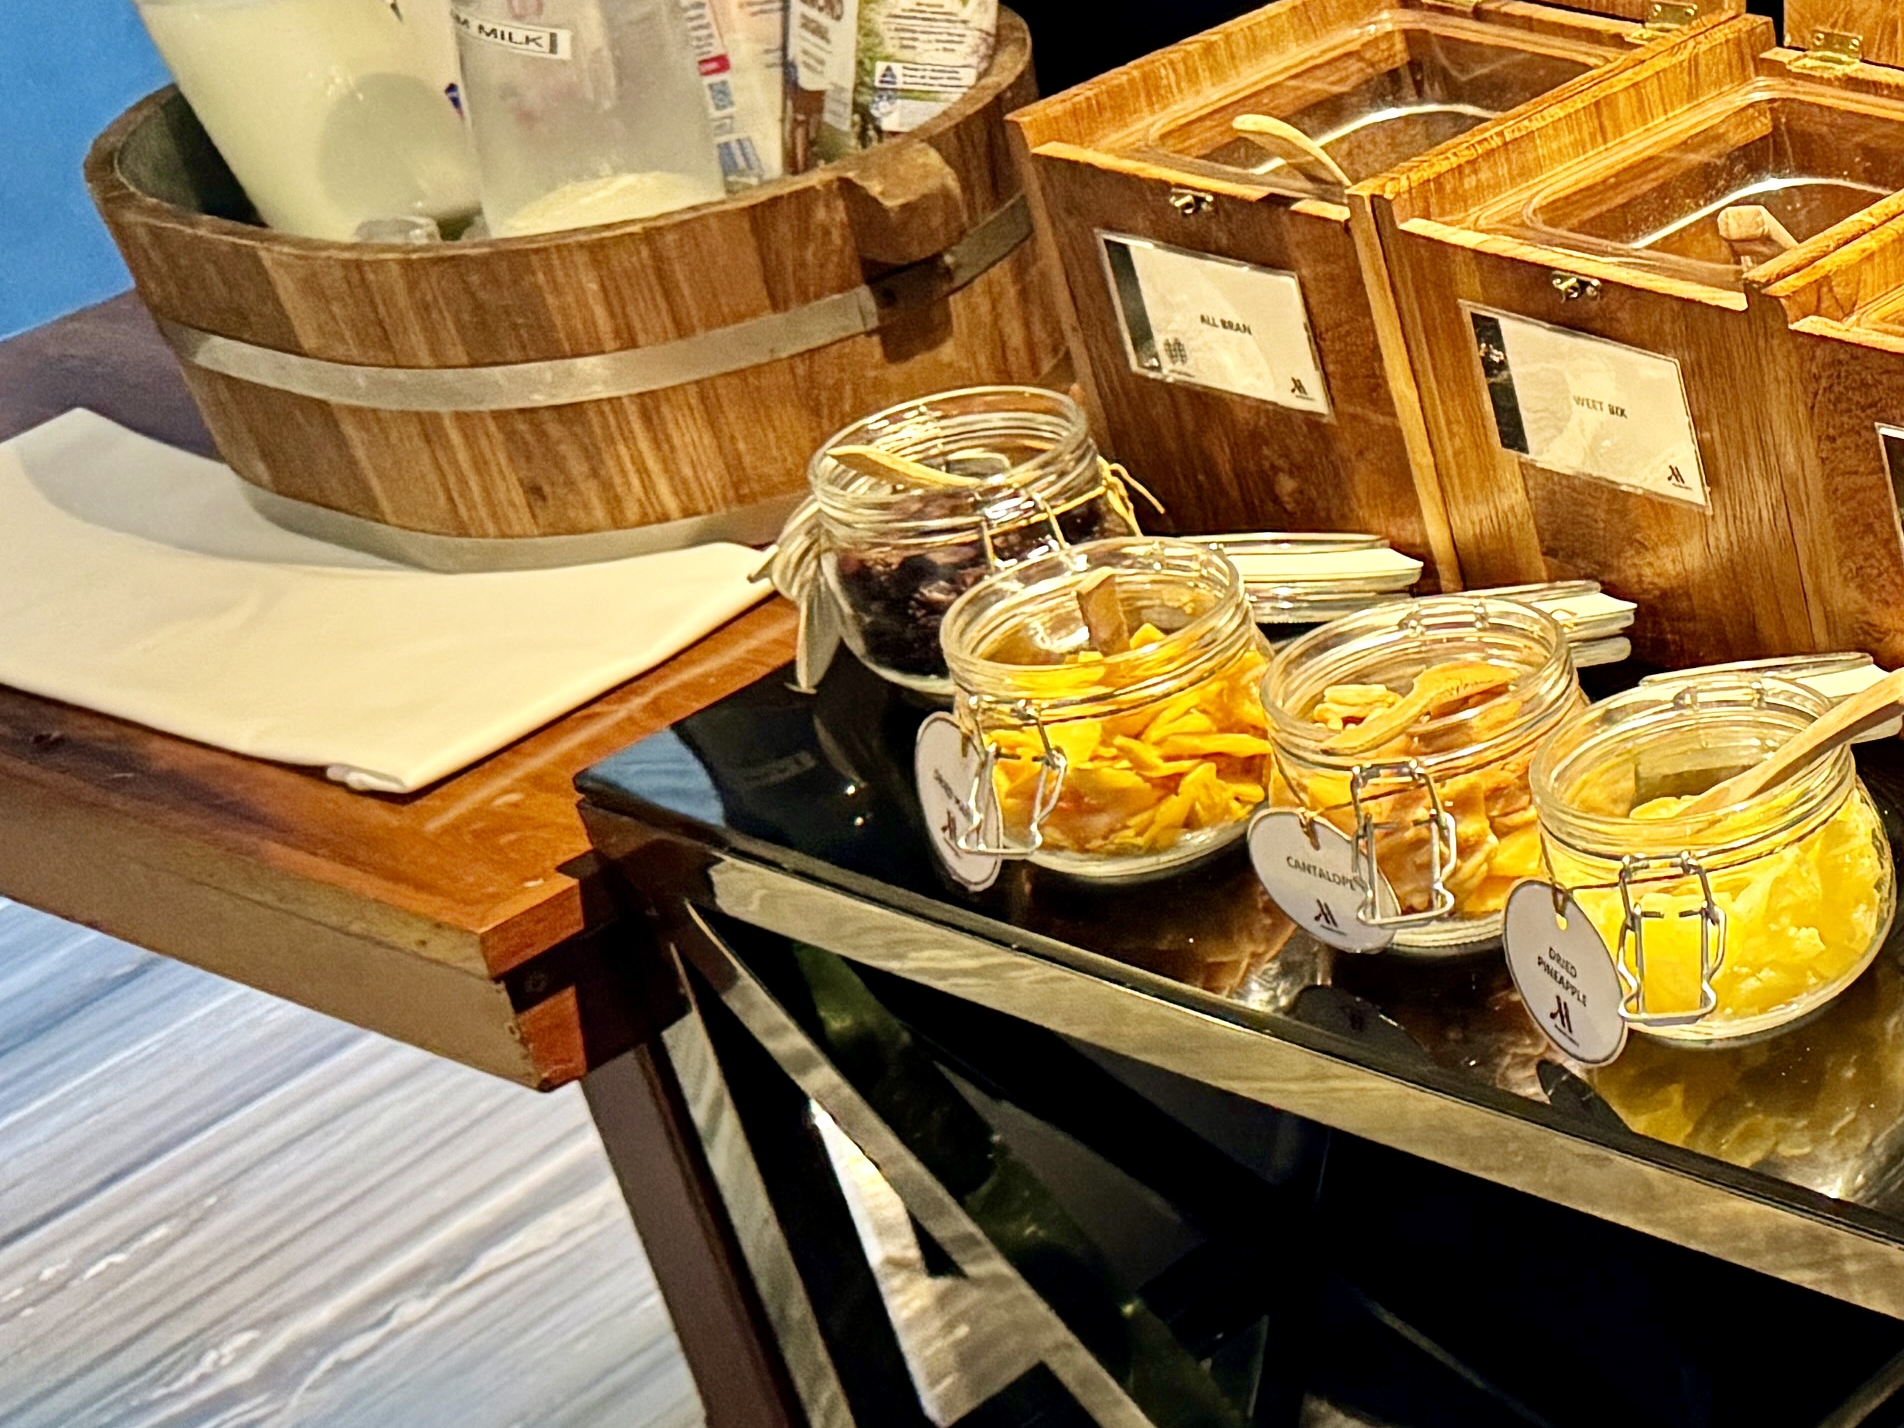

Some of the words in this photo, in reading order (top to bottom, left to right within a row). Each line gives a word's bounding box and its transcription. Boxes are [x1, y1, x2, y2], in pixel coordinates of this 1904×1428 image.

[477, 24, 544, 48] MILK
[1549, 946, 1577, 979] DRIED
[1537, 955, 1588, 1008] PINEAPPLE
